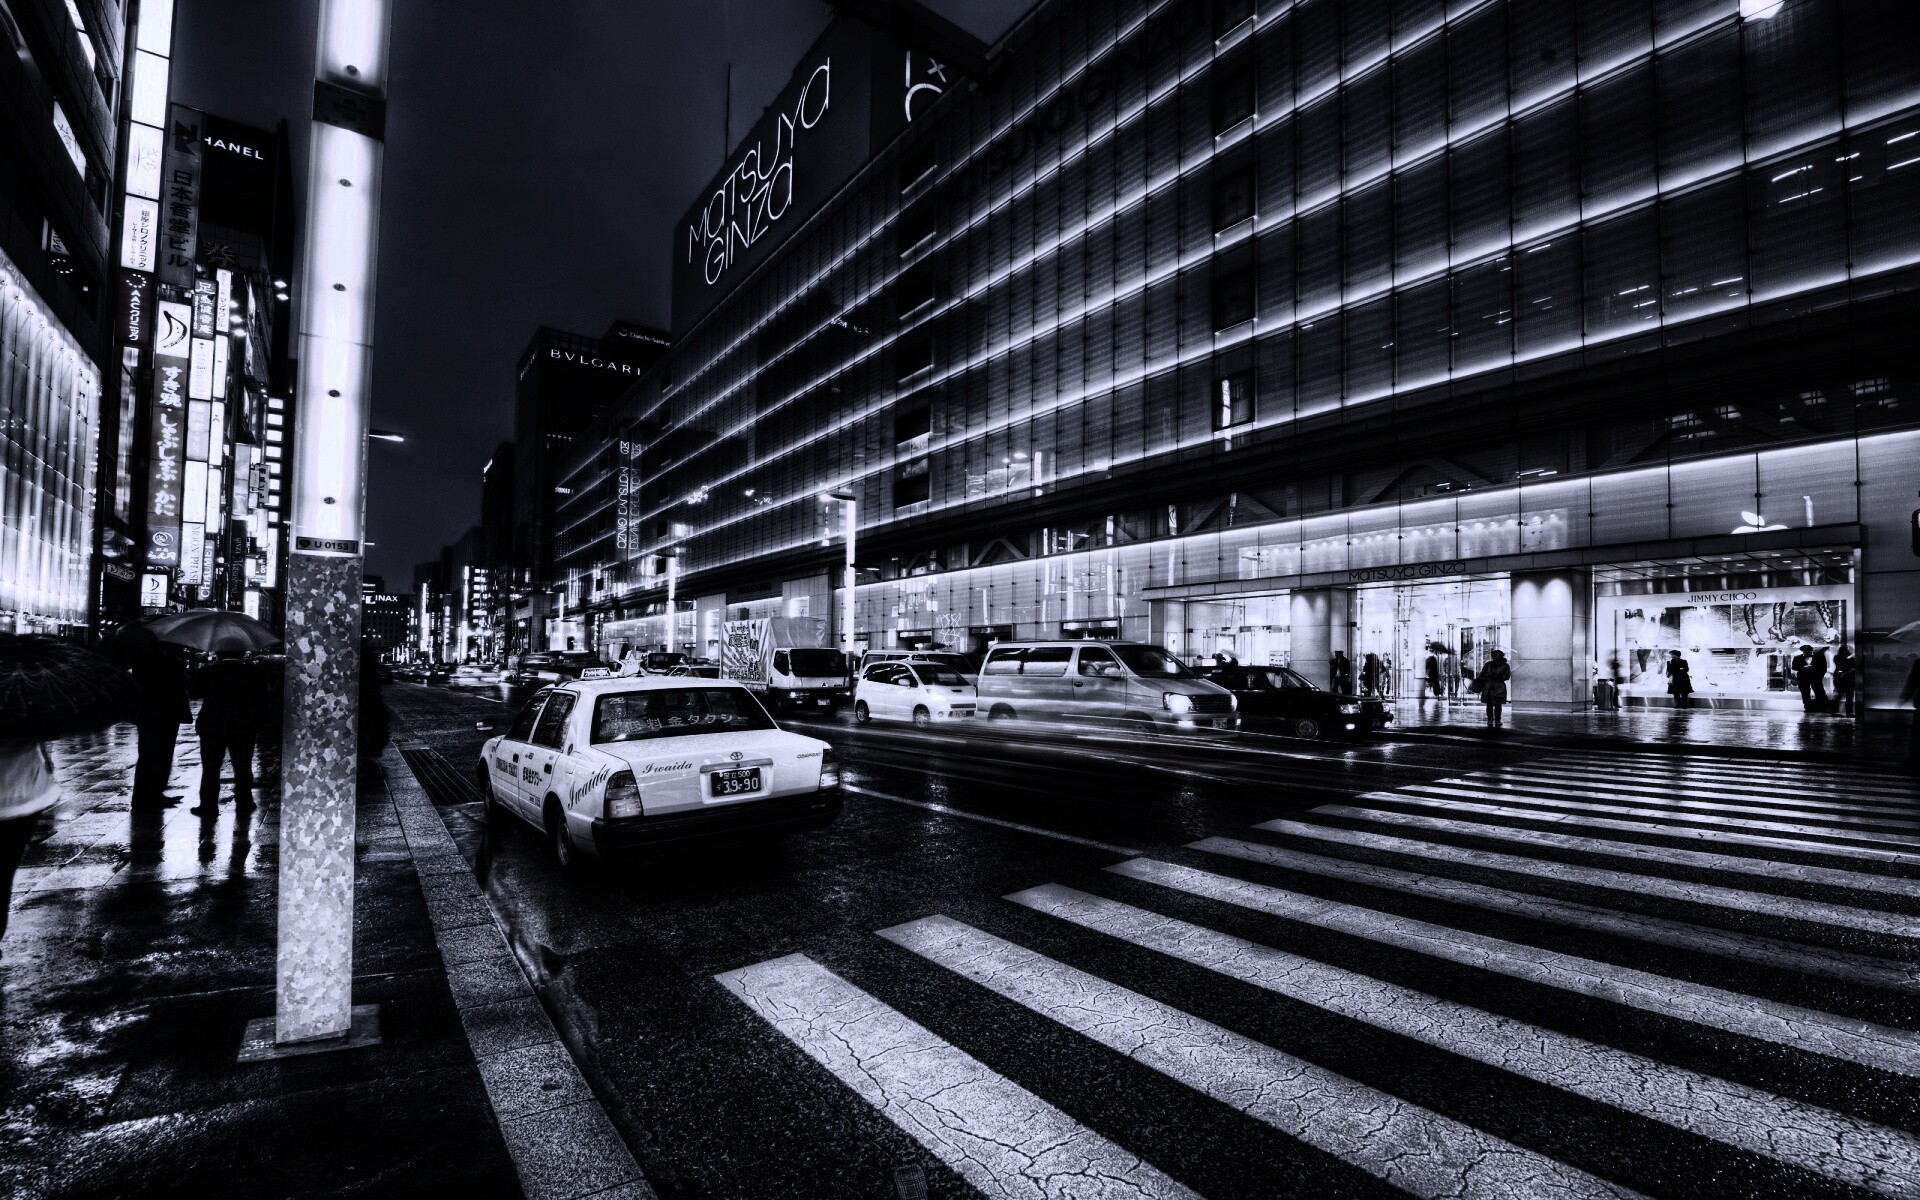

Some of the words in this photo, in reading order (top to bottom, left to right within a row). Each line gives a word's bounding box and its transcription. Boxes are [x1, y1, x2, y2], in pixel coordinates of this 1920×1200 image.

[204, 136, 264, 161] HANEL
[550, 349, 641, 376] BVLGARI
[191, 525, 201, 551] MOON
[315, 541, 322, 549] U
[324, 541, 349, 550] 0153
[189, 556, 199, 584] PHASE
[375, 594, 399, 602] INAX
[1688, 594, 1718, 603] JIMMY
[1720, 592, 1757, 601] CHOO
[738, 769, 751, 778] 500
